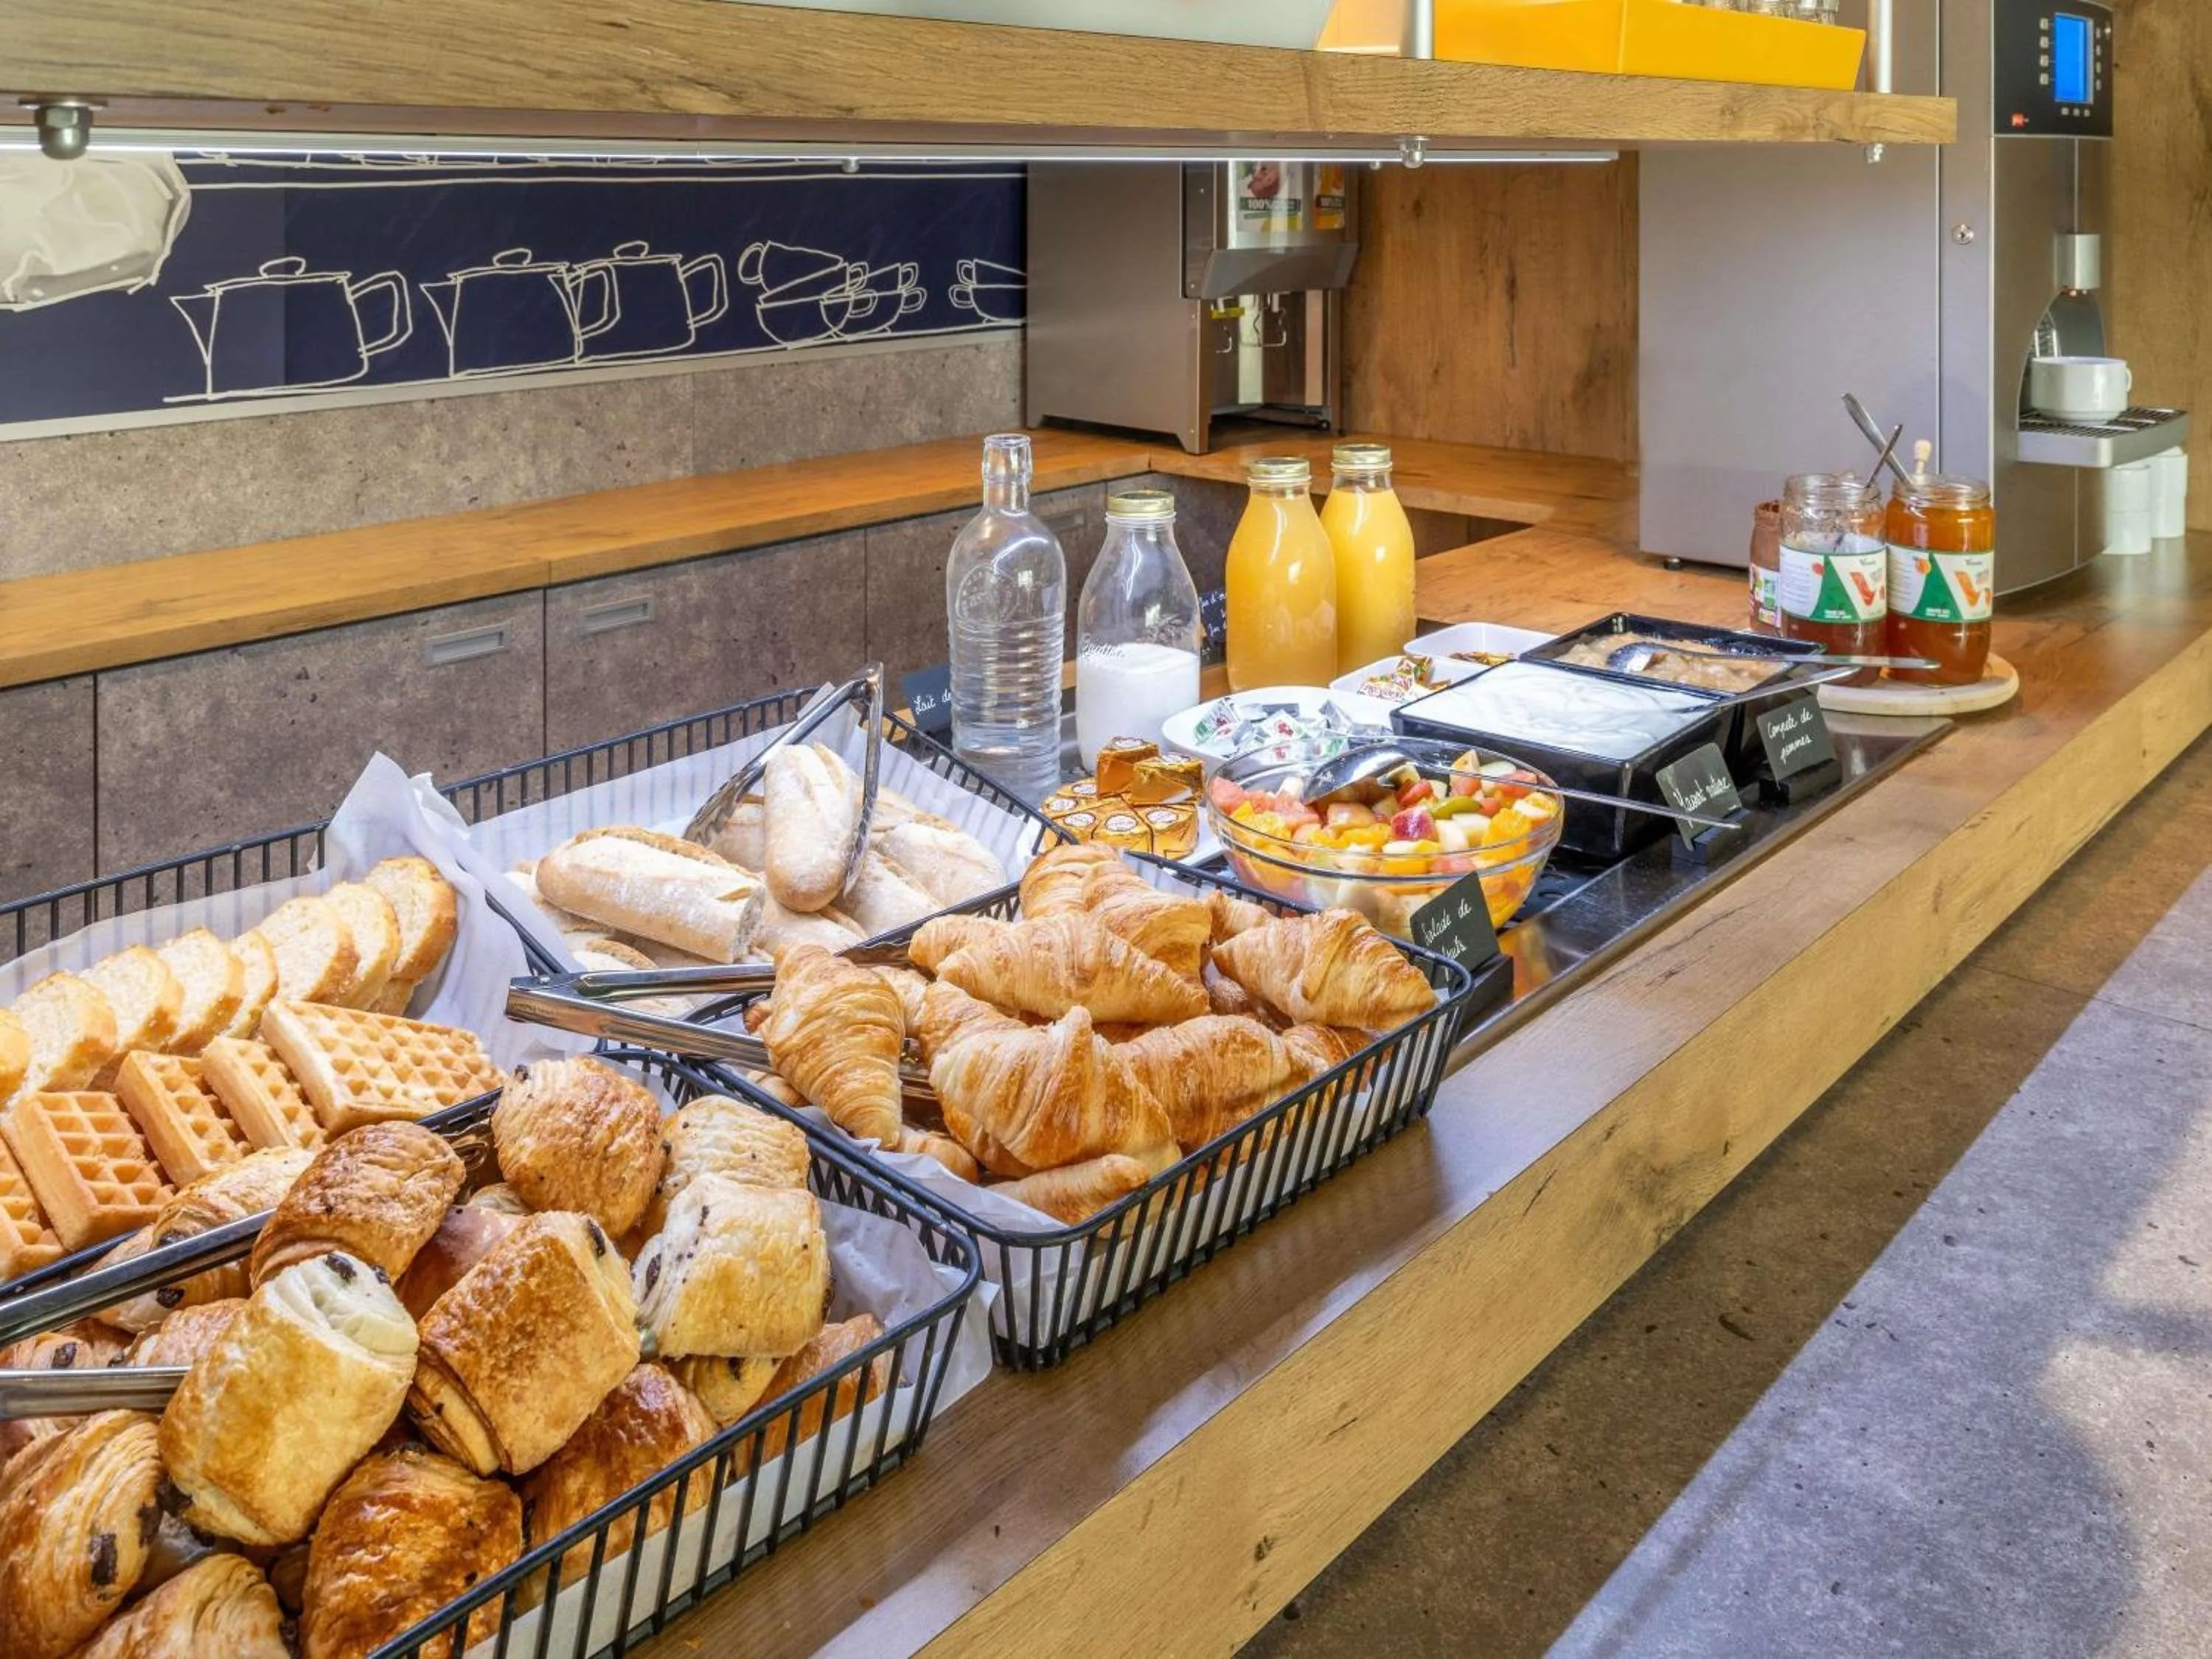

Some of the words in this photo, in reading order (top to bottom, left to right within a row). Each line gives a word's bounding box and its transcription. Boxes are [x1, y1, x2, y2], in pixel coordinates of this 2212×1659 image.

[914, 695, 936, 716] Lait
[1800, 707, 1813, 723] de
[1458, 897, 1472, 919] de
